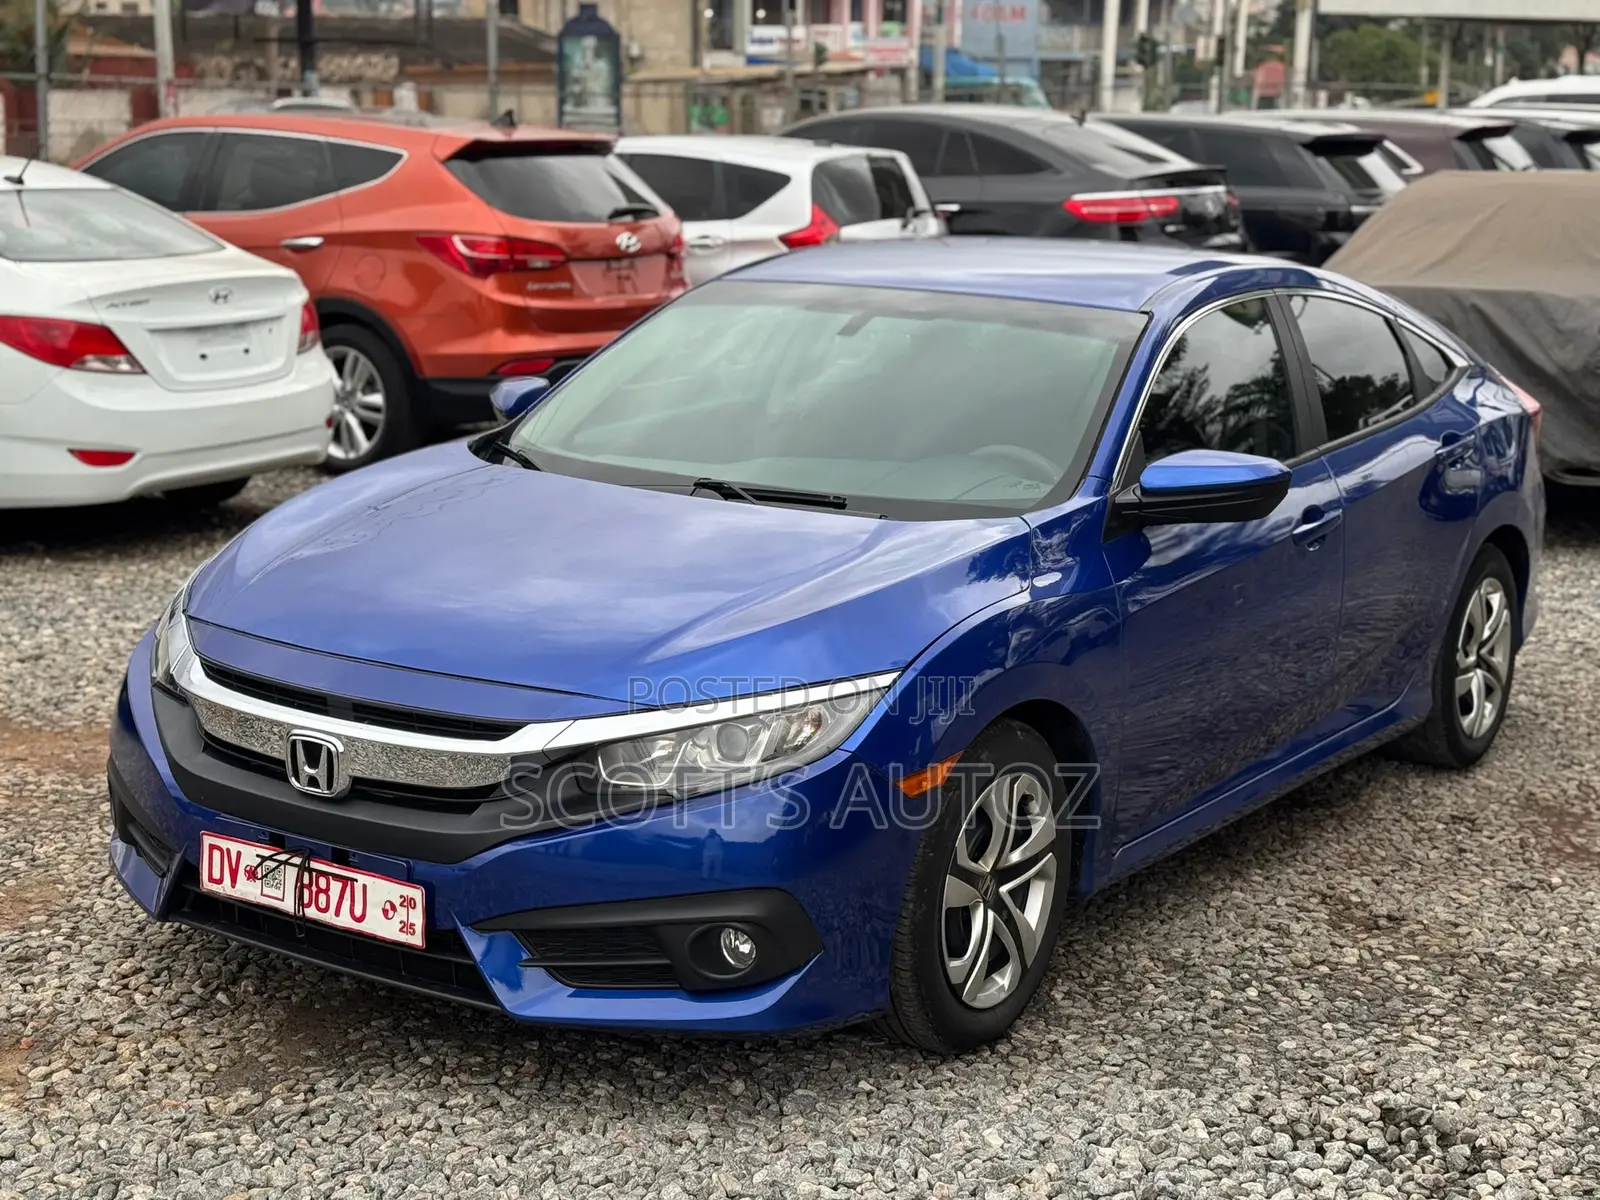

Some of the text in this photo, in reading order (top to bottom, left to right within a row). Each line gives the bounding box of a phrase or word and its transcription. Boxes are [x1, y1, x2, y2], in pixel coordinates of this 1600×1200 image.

[207, 843, 242, 889] DV
[399, 895, 417, 909] 20
[398, 920, 416, 936] 25
